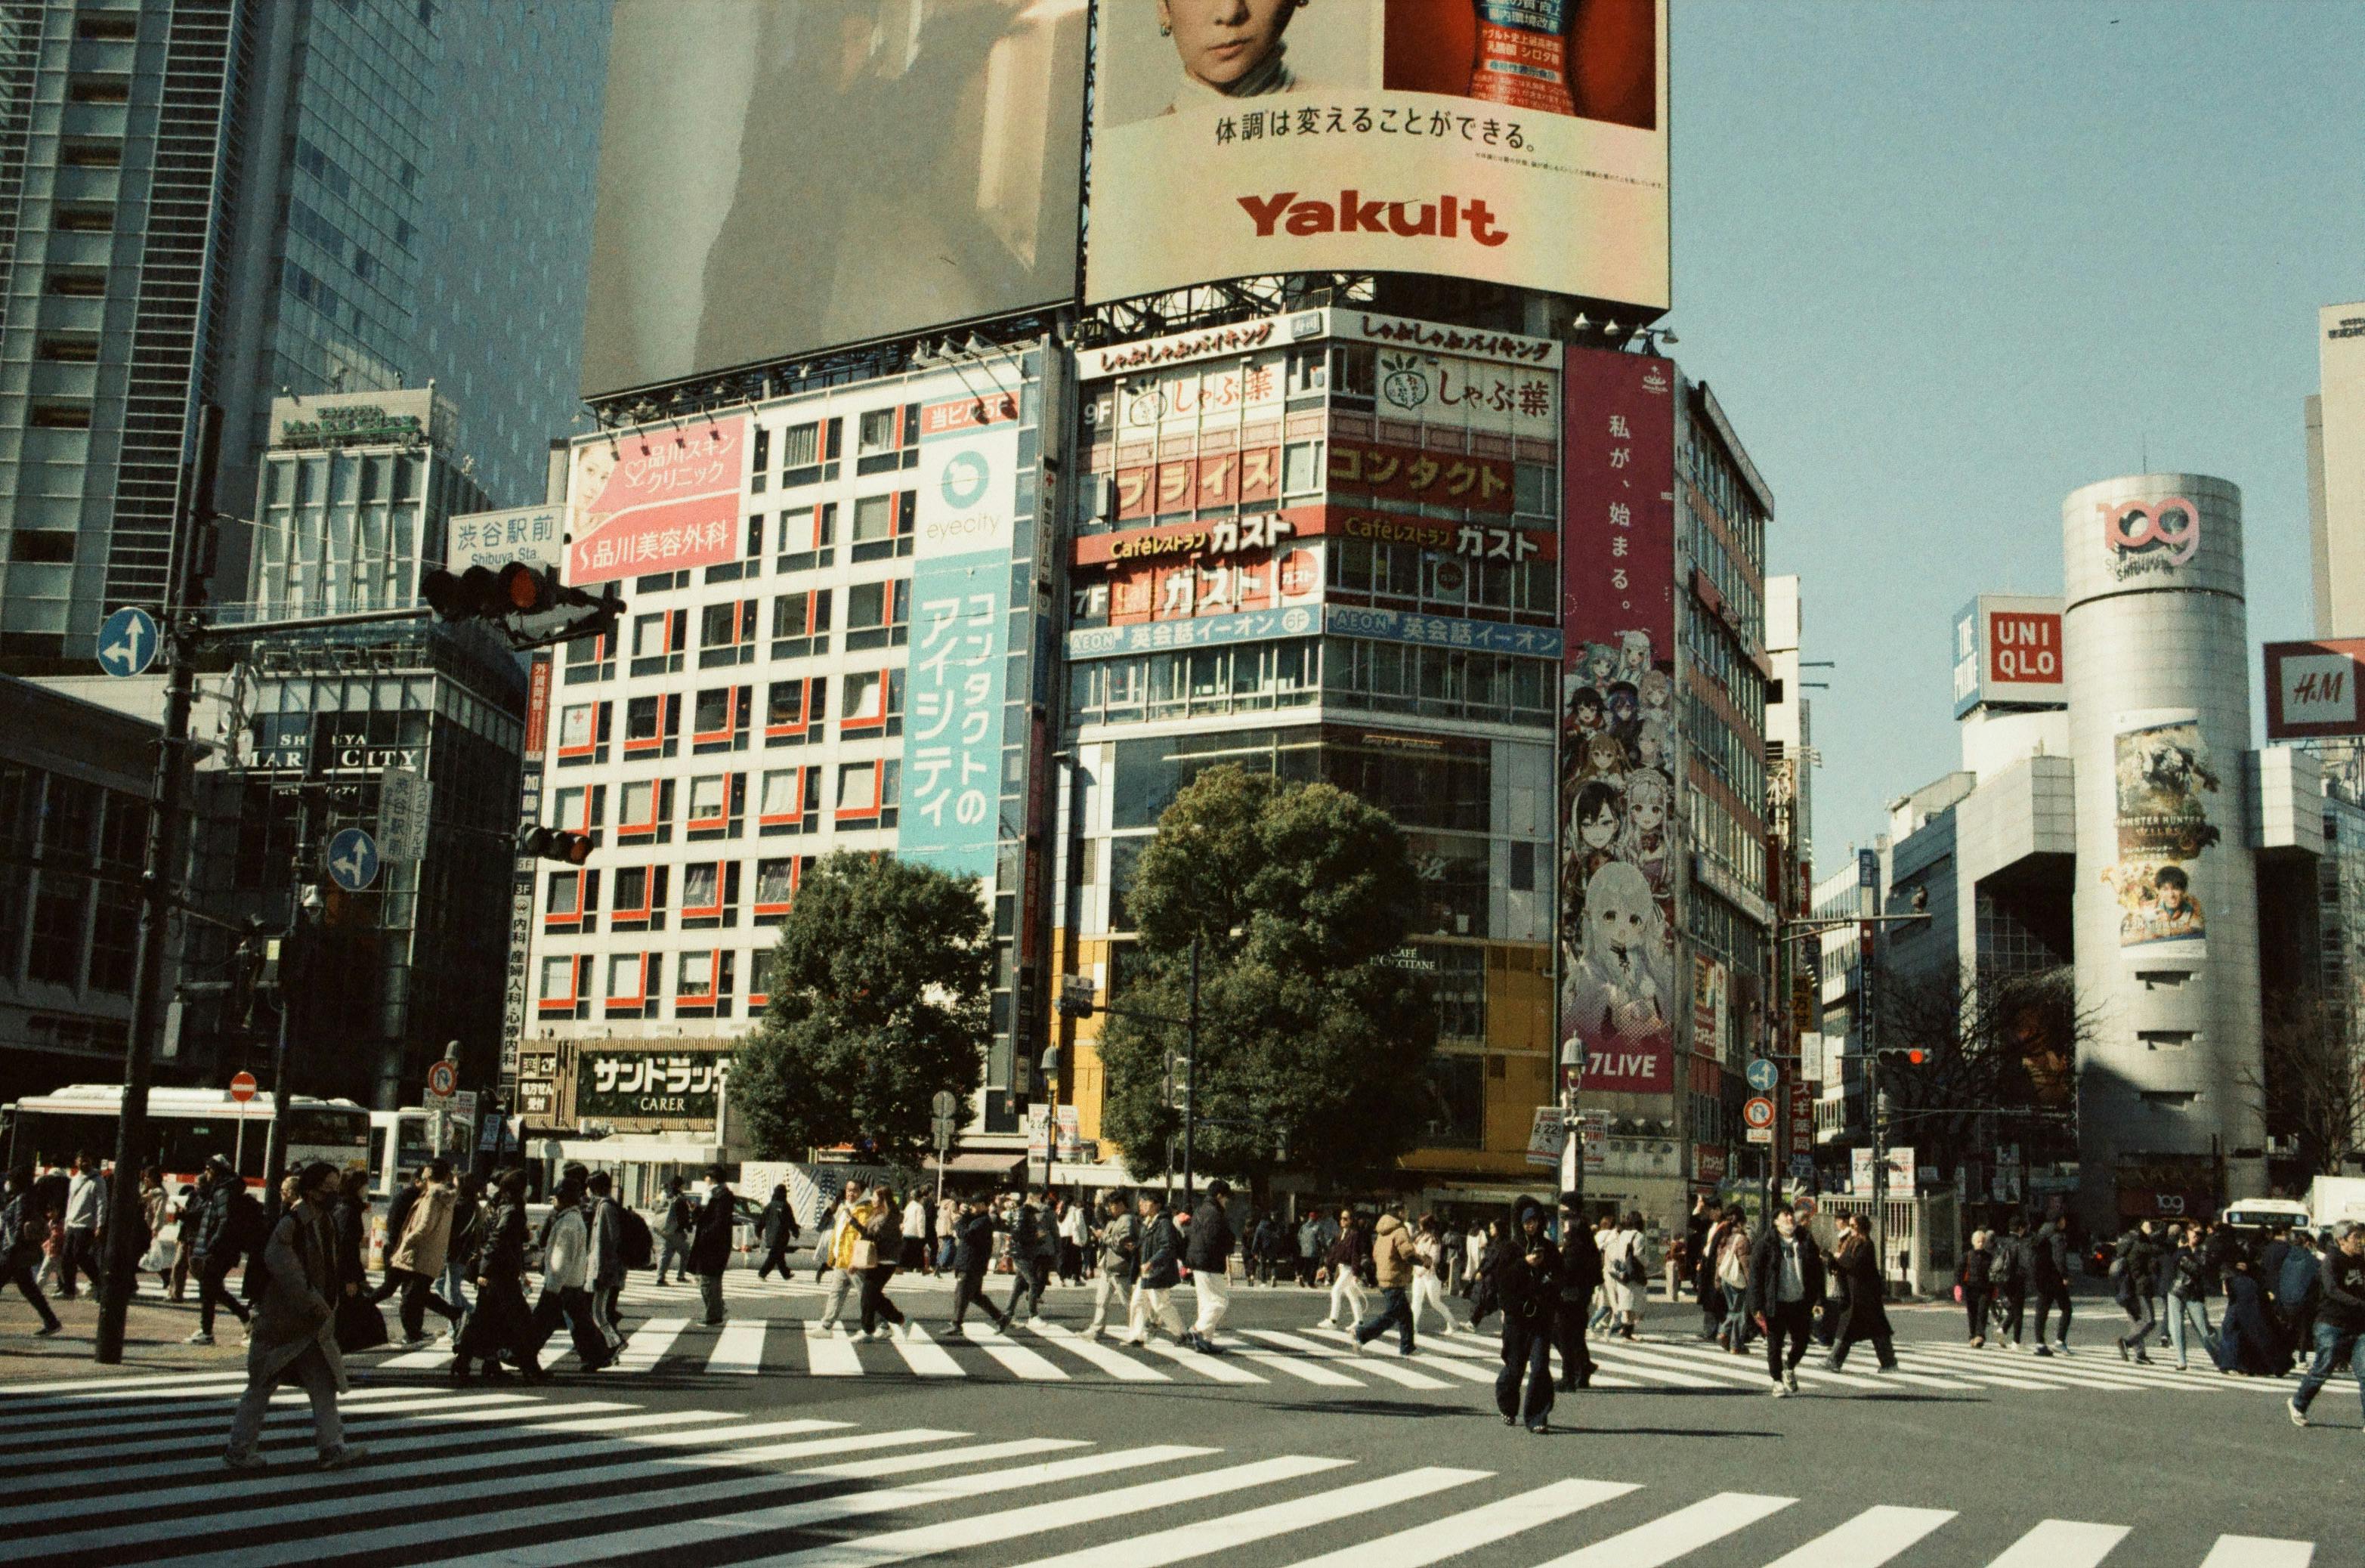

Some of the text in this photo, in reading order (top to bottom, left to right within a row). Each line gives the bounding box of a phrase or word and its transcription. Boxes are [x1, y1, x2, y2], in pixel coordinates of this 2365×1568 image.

[1237, 189, 1509, 247] Yakult
[1100, 320, 1275, 373] しゃぶしゃぶバイキング
[1362, 314, 1552, 361] しゃぶしゃぶバイキング
[1174, 366, 1274, 413] しゃぶ葉
[1439, 369, 1550, 416] しゃぶ葉
[1084, 400, 1111, 425] 9F
[648, 435, 735, 469] 品川スキン
[648, 460, 725, 493] クリニック
[1328, 451, 1507, 499] コンタクト
[926, 513, 1001, 543] eyecity
[1609, 415, 1631, 611] 私が、始まる。
[457, 515, 555, 551] 渋谷駅前
[592, 518, 729, 568] 品川美容外科
[1210, 512, 1293, 555] ガスト
[1456, 524, 1539, 562] ガスト
[2096, 496, 2200, 566] 109
[471, 552, 514, 567] Shibuya
[1162, 567, 1263, 619] ガスト
[1281, 571, 1318, 585] ガスト
[1074, 584, 1108, 616] 7F
[1071, 632, 1117, 654] AEON
[1285, 611, 1307, 629] 6F
[1334, 609, 1391, 632] AEON
[1998, 620, 2049, 646] UNI
[1999, 649, 2055, 679] QLO
[2292, 671, 2345, 706] H&M
[913, 597, 960, 827] アイシティ
[956, 592, 996, 825] コンタクトの
[280, 734, 366, 746] SHUYA
[341, 749, 418, 766] CITY
[2162, 816, 2202, 824] HUNTER
[515, 884, 530, 895] 3F
[512, 917, 527, 945] 内科
[523, 1059, 556, 1078] 薬 2F
[1581, 1052, 1657, 1078] 7LIVE
[521, 1082, 553, 1096] 処方せん
[640, 1098, 685, 1112] CARER
[2156, 1195, 2184, 1215] 109
